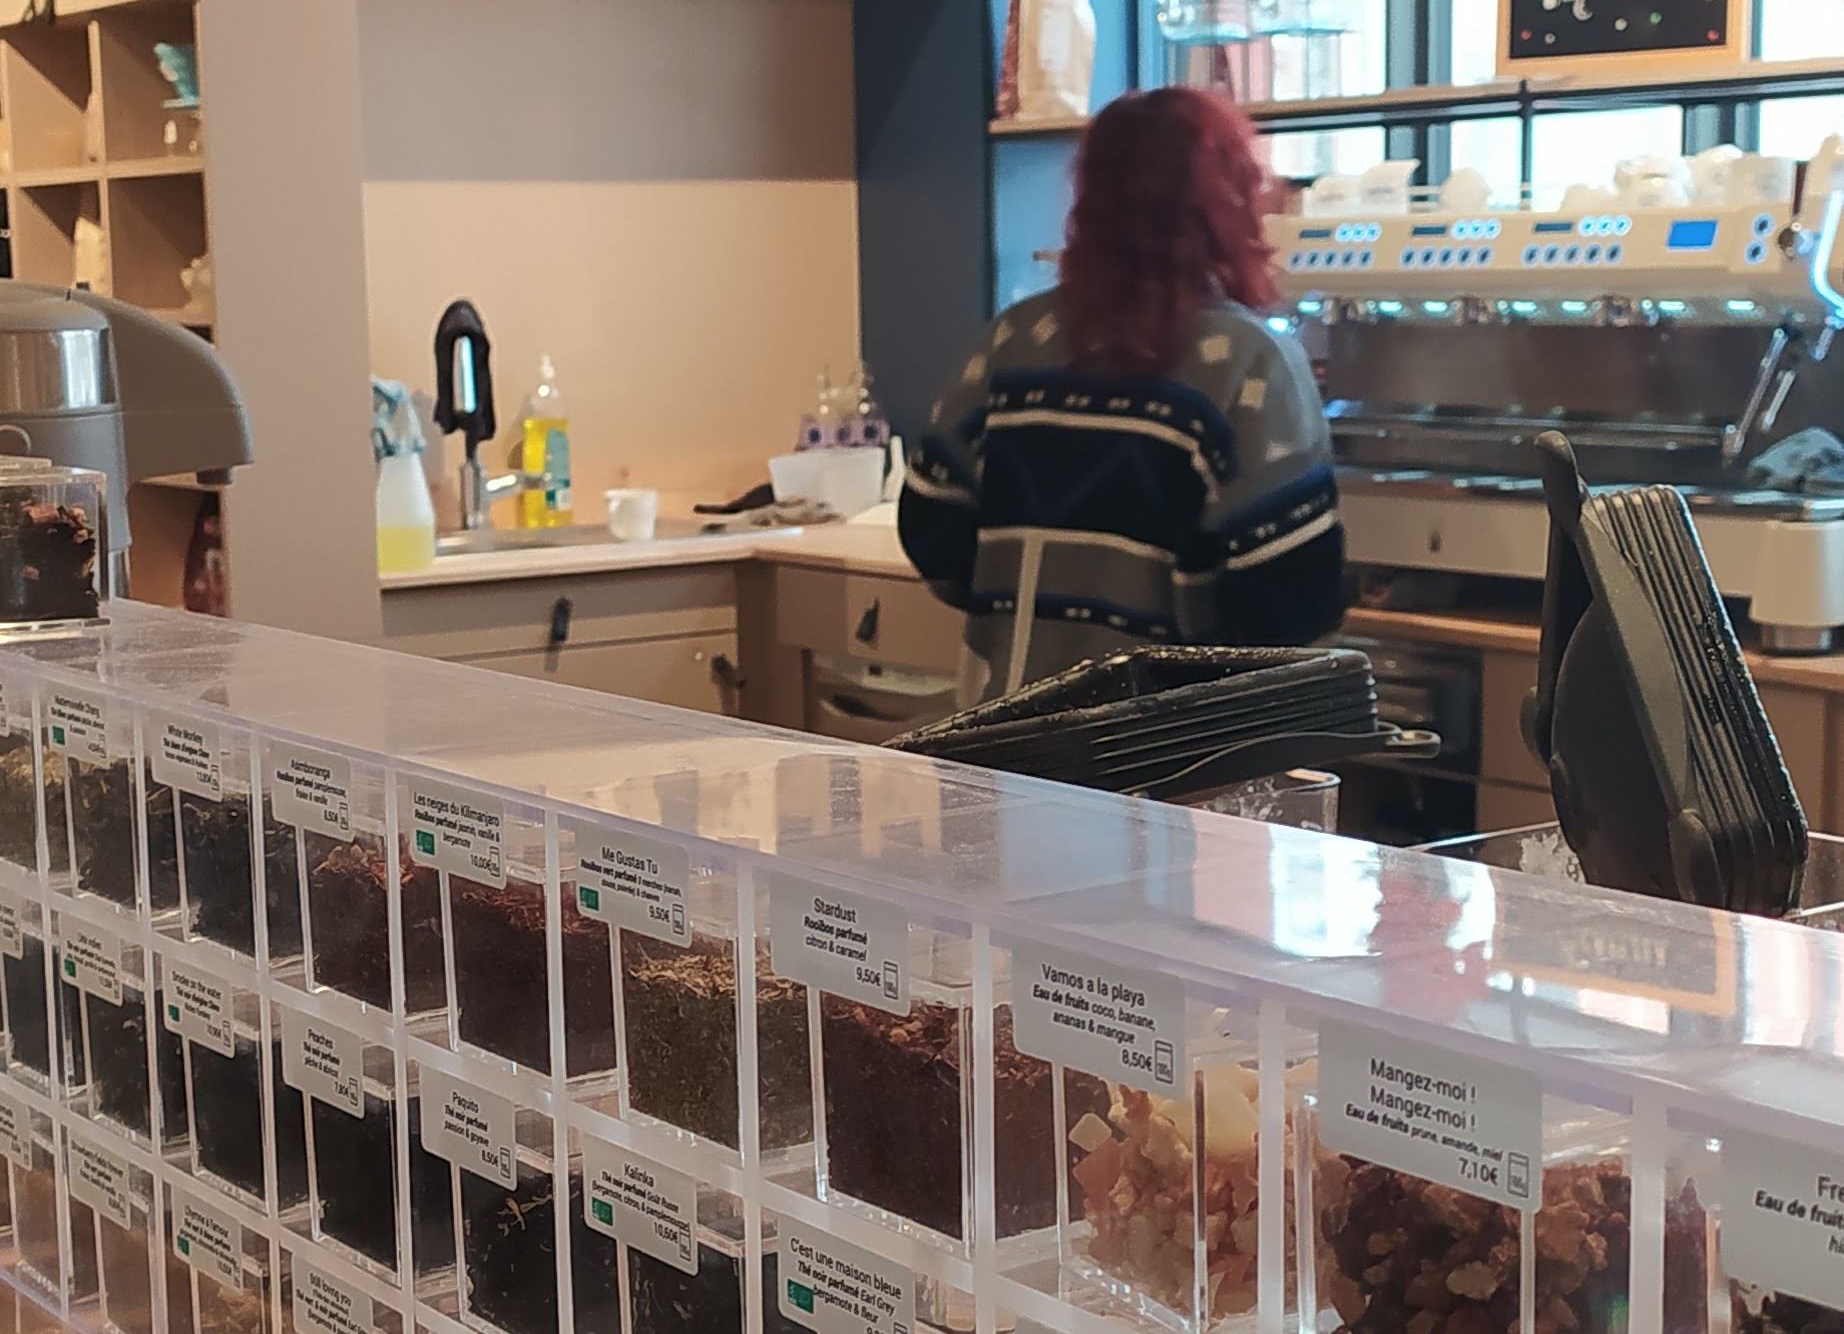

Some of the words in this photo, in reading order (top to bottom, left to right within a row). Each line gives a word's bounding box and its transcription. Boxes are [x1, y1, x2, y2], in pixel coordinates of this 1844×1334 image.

[602, 847, 614, 862] Me
[616, 851, 645, 870] Gustas
[646, 859, 658, 874] Tu
[814, 898, 856, 923] Stardust
[835, 928, 867, 945] parfumé
[836, 944, 867, 961] caramel
[856, 967, 881, 987] 9,50€
[1042, 964, 1083, 990] Vamos
[1087, 980, 1094, 992] a
[1097, 977, 1108, 996] la
[1112, 984, 1145, 1008] playa
[1033, 984, 1050, 1000] Eau
[1052, 990, 1062, 1003] de
[1065, 992, 1089, 1011] fruits
[1092, 1002, 1116, 1020] coco,
[1118, 1007, 1155, 1032] banane,
[1053, 1012, 1086, 1029] ananas
[1088, 1019, 1094, 1033] &
[1097, 1024, 1135, 1044] mangue
[1122, 1048, 1152, 1072] 8,50€
[1370, 1058, 1466, 1101] Mangez-moi
[1370, 1086, 1466, 1129] Mangez-moi
[1346, 1103, 1365, 1120] Eau
[1367, 1110, 1379, 1125] de
[1382, 1113, 1409, 1134] fruits
[1411, 1127, 1438, 1143] prune,
[1442, 1135, 1480, 1156] amande,
[1482, 1147, 1503, 1161] miel
[1458, 1158, 1498, 1185] 7,10€
[1755, 1190, 1784, 1212] Eau
[1787, 1199, 1806, 1218] de
[791, 1238, 813, 1260] C'est
[816, 1251, 833, 1269] une
[836, 1260, 871, 1286] maison
[874, 1274, 901, 1300] bleue
[798, 1260, 811, 1276] Thé
[813, 1268, 827, 1283] noir
[828, 1277, 859, 1299] parfumé
[861, 1290, 875, 1306] Earl
[877, 1301, 895, 1317] Grey
